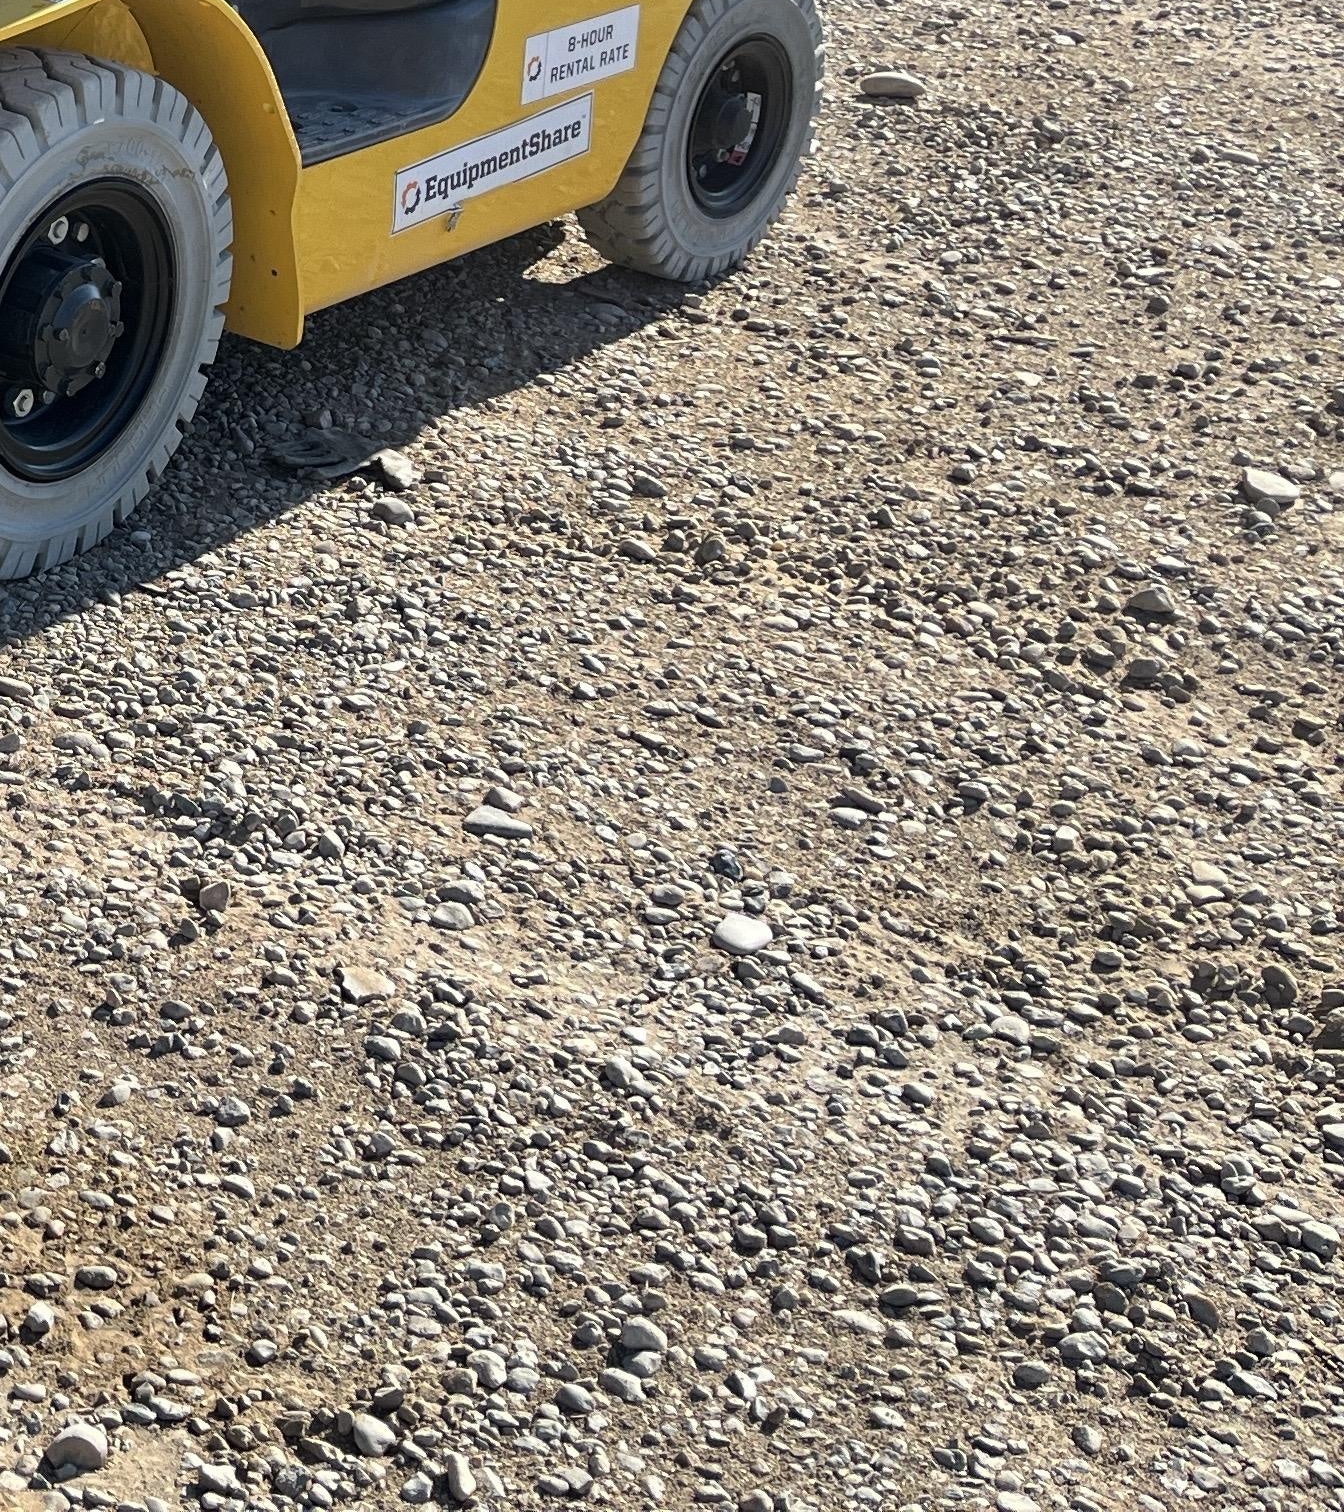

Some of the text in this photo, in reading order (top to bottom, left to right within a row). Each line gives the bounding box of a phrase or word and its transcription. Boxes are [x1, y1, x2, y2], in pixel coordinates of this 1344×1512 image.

[567, 24, 614, 53] 8-HOUR
[550, 43, 630, 84] RENTAL RATE
[424, 119, 582, 203] EquipmentShare
